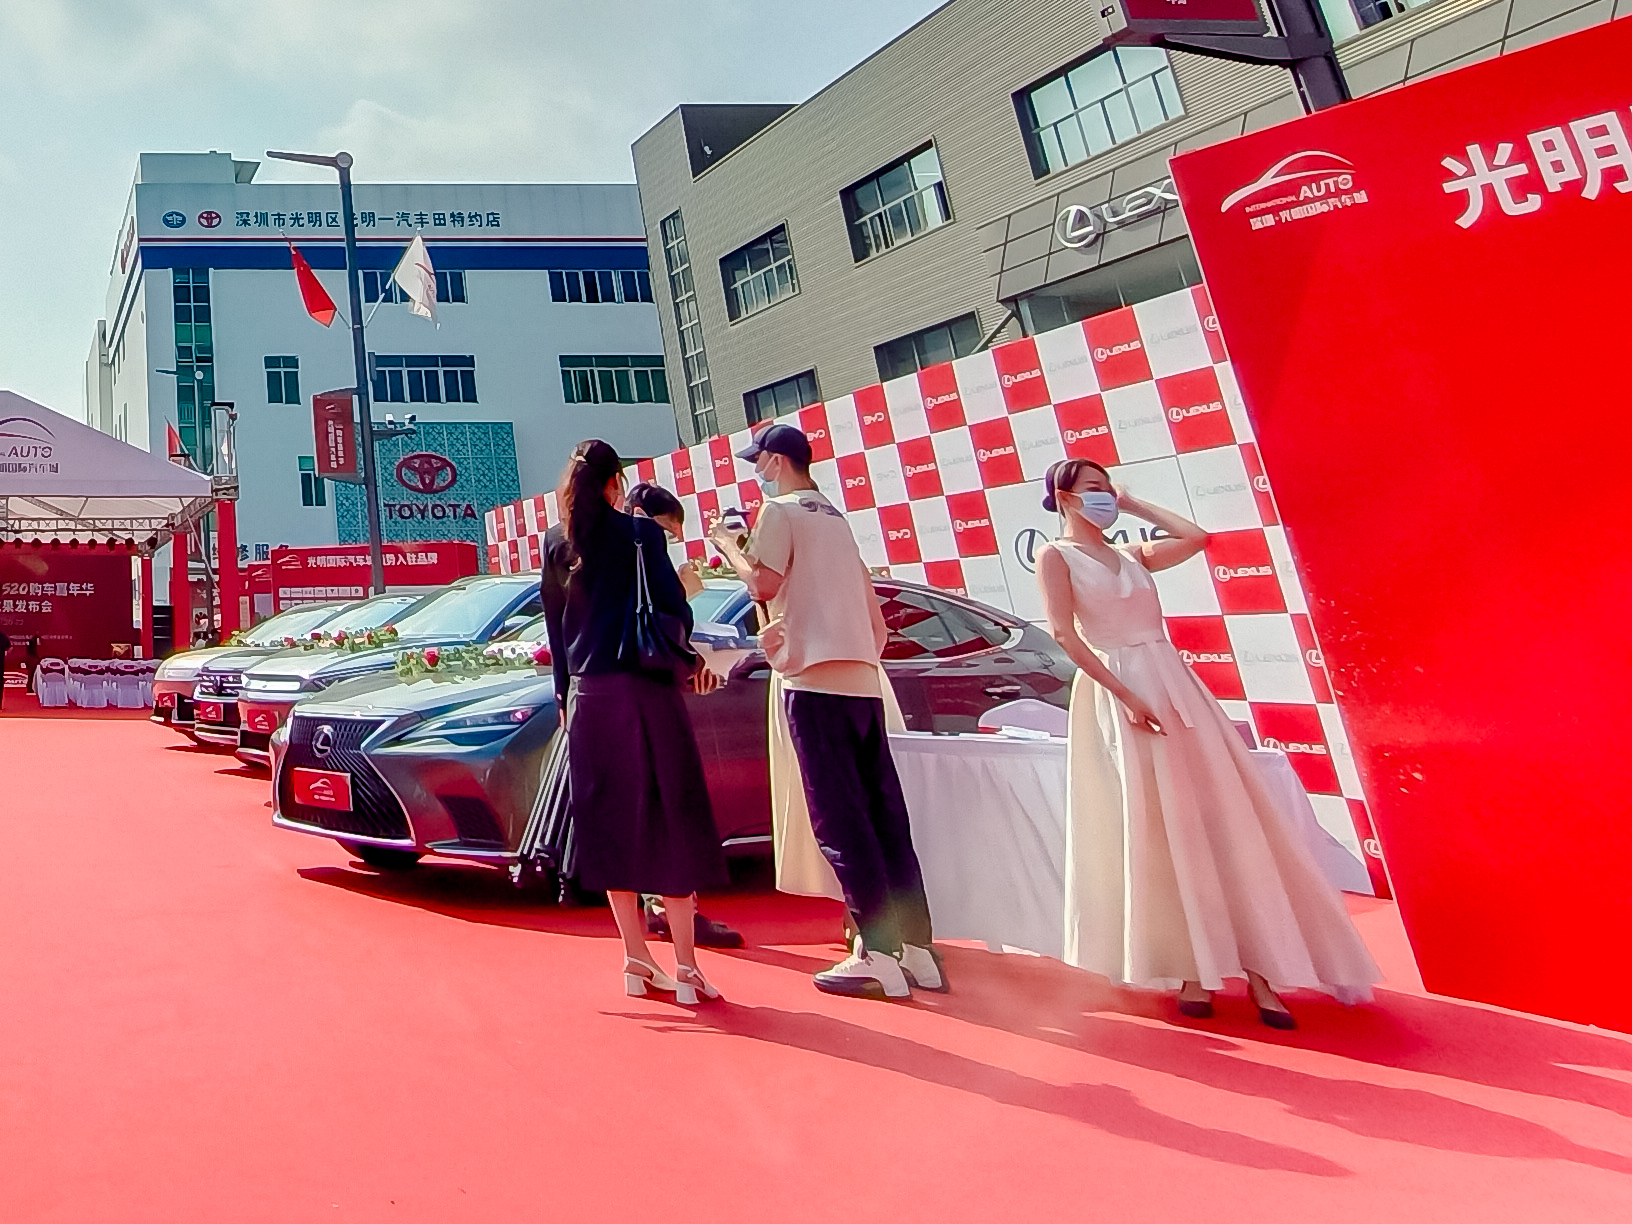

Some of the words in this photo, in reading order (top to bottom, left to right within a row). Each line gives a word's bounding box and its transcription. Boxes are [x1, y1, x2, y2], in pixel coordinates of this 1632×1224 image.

[1440, 109, 1632, 229] 光明
[1299, 174, 1353, 201] AUTO
[1101, 177, 1179, 223] LEX
[1183, 401, 1222, 417] LEXUS
[8, 445, 53, 458] AUTO
[384, 504, 478, 520] TOYOTA
[1229, 565, 1272, 577] LEXUS
[1192, 653, 1233, 663] LEXUS
